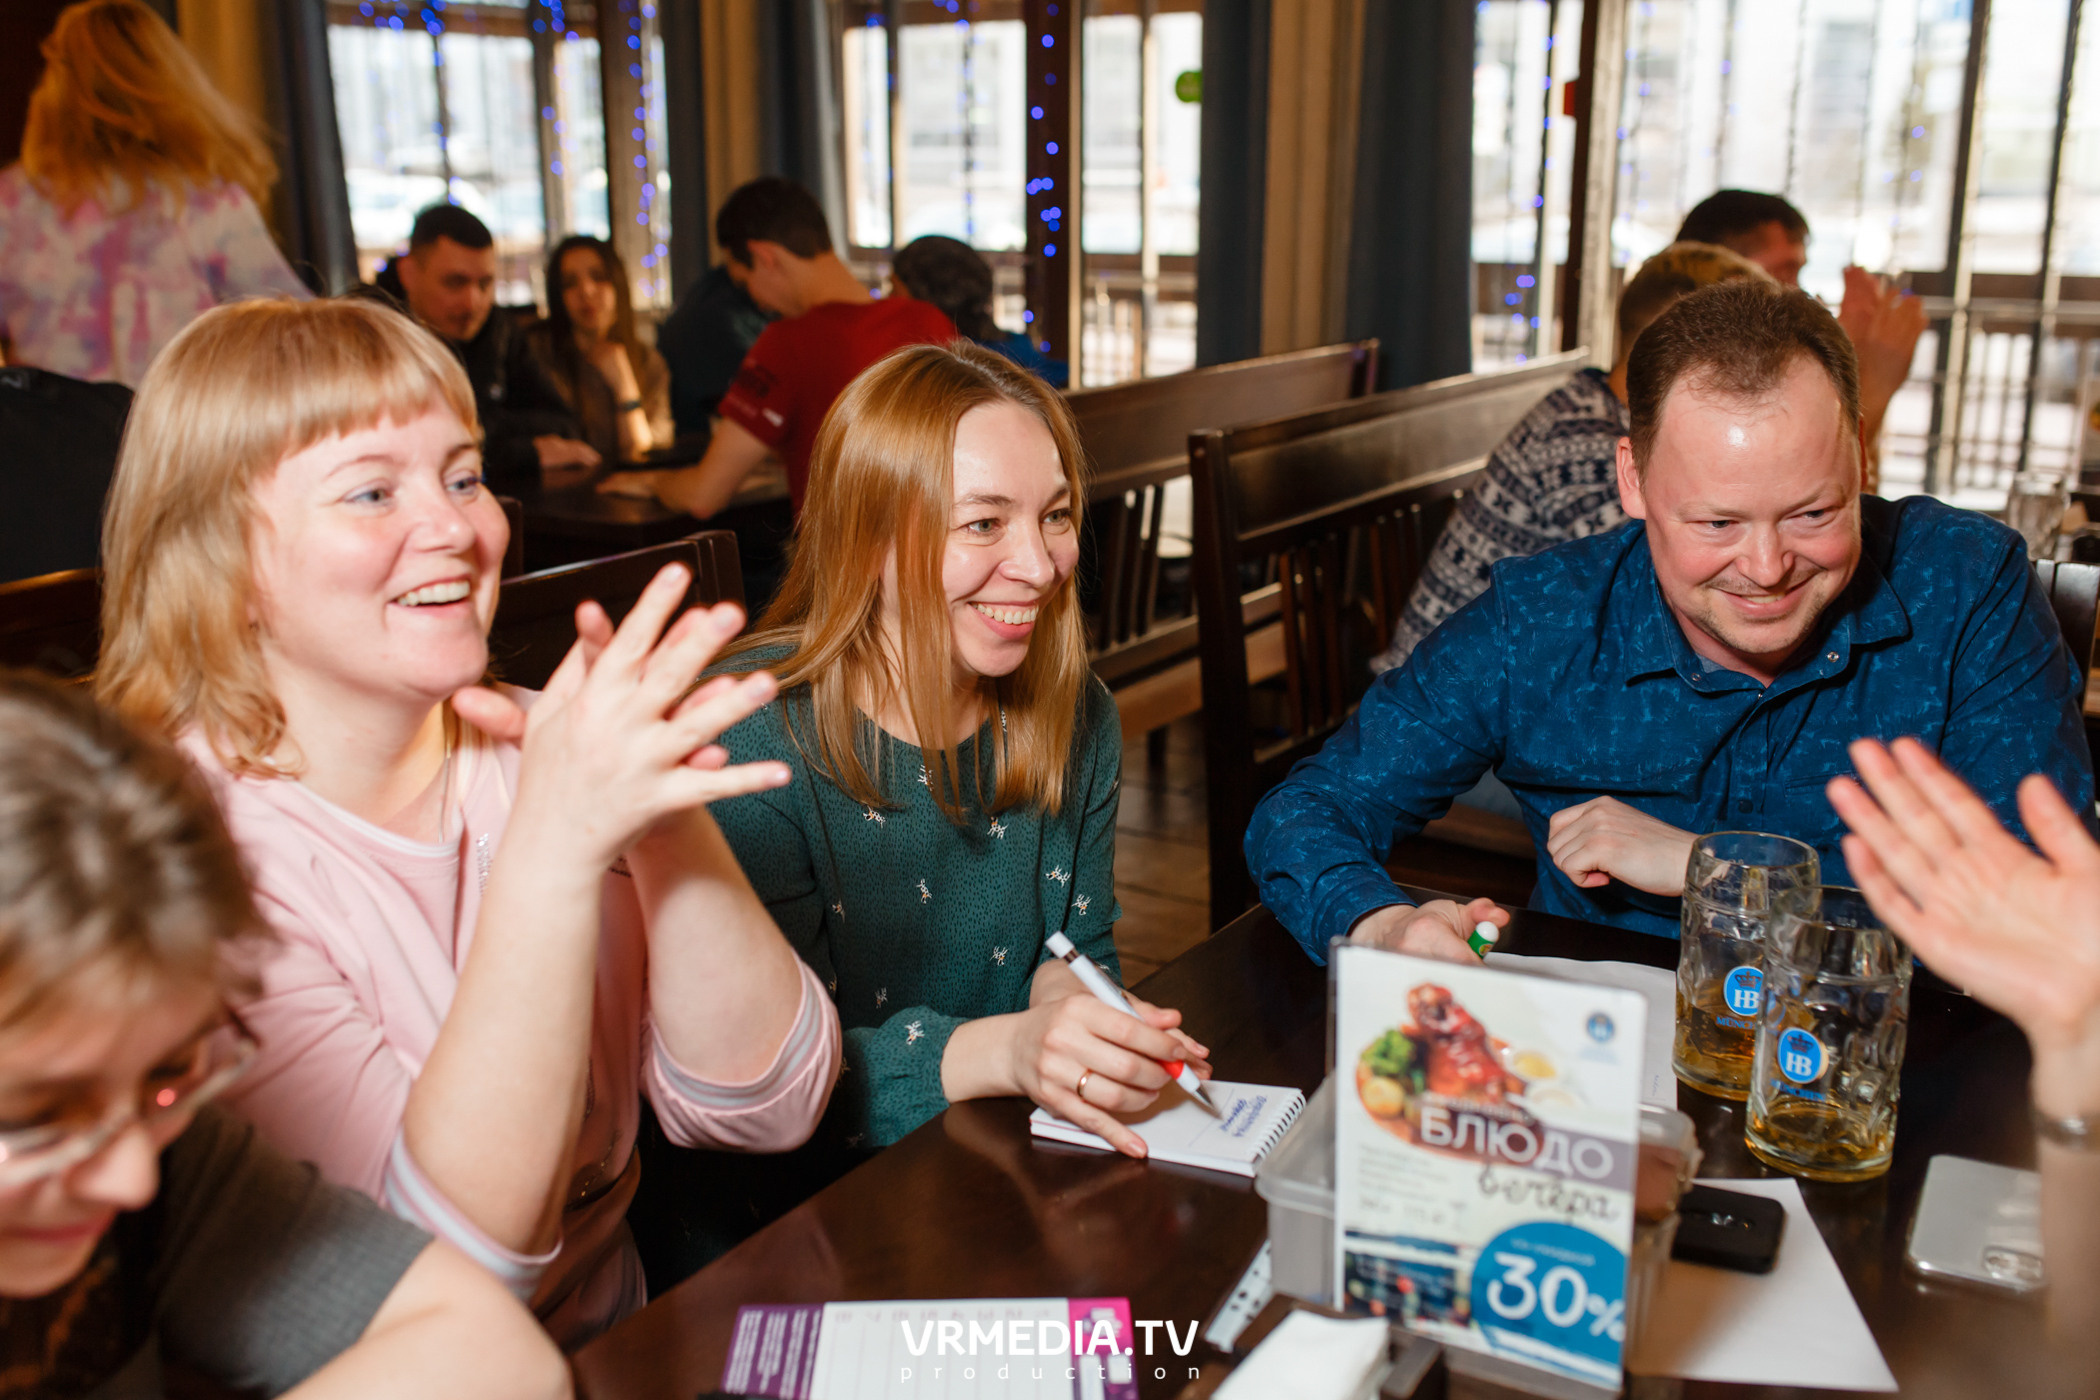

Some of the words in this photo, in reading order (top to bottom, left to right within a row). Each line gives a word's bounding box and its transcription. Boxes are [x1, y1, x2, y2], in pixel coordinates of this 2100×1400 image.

[1733, 988, 1760, 1009] HB
[1716, 1015, 1753, 1030] MÜNC
[1785, 1051, 1813, 1077] HB
[1420, 1105, 1614, 1179] БЛЮДО
[1486, 1251, 1626, 1342] 30%
